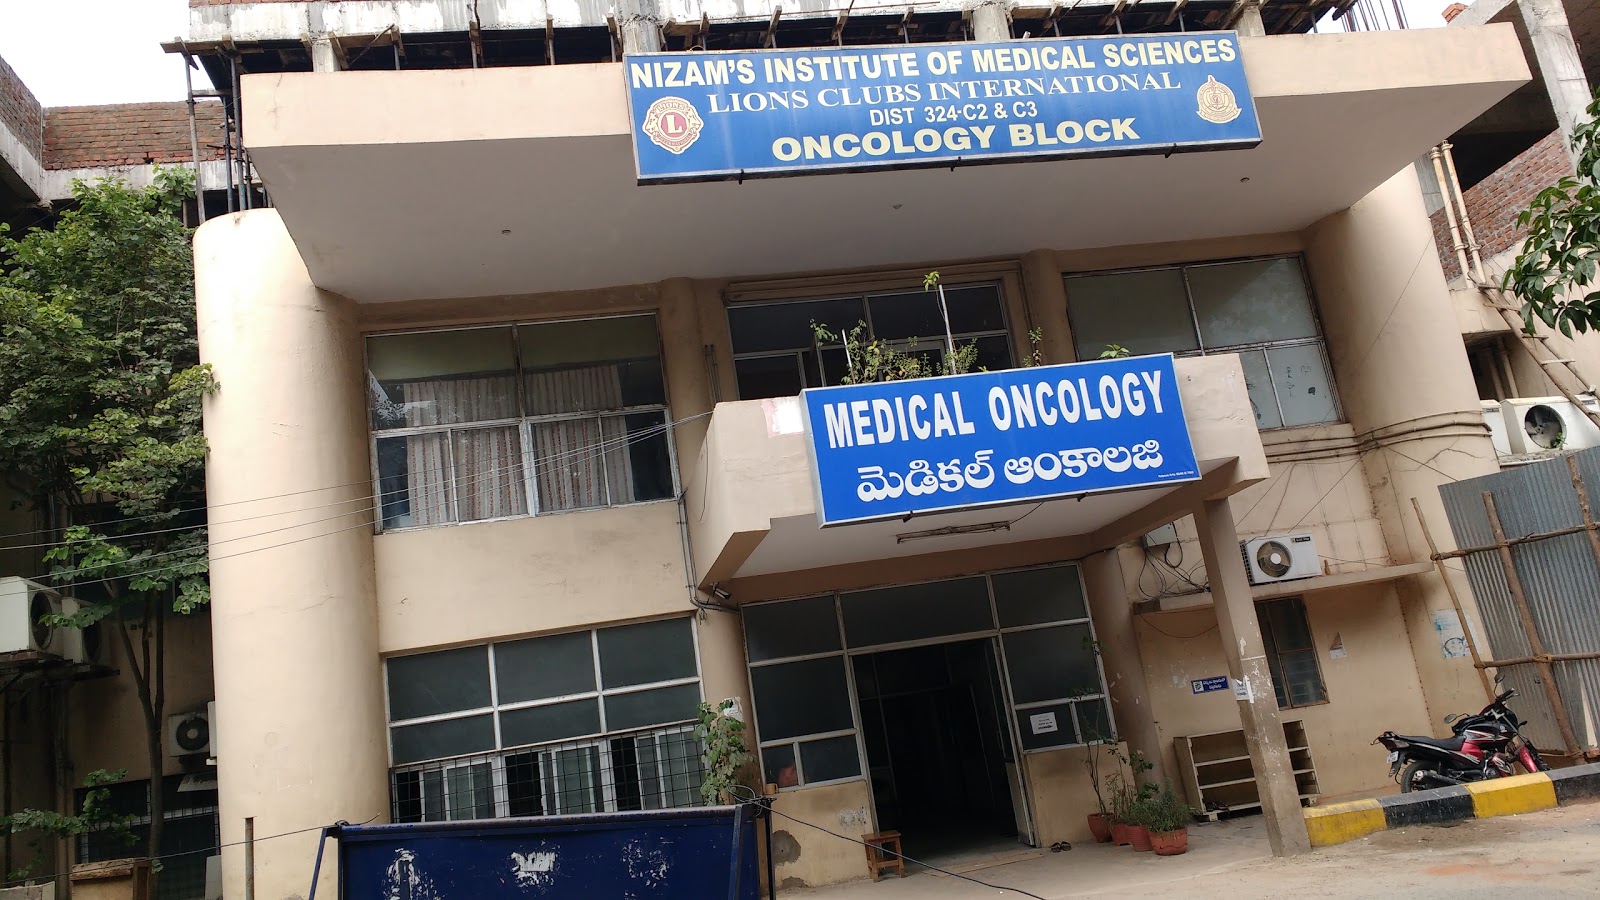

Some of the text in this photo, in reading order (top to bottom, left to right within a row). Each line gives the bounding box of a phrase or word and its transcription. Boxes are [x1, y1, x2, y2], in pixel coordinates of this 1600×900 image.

[630, 39, 1236, 88] NIZAM'S INSTITUTE OF MEDICAL SCIENCES
[656, 101, 686, 113] LIONS
[707, 72, 1181, 113] LIONS CLUBS INTERNATIONAL
[869, 101, 1038, 126] DIST 324-C2 & C3
[665, 114, 683, 134] L
[771, 117, 1141, 161] ONCOLOGY BLOCK
[823, 370, 1164, 449] MEDICAL ONCOLOGY
[856, 439, 1164, 502] మెడికల్ ఆంకాలజి
